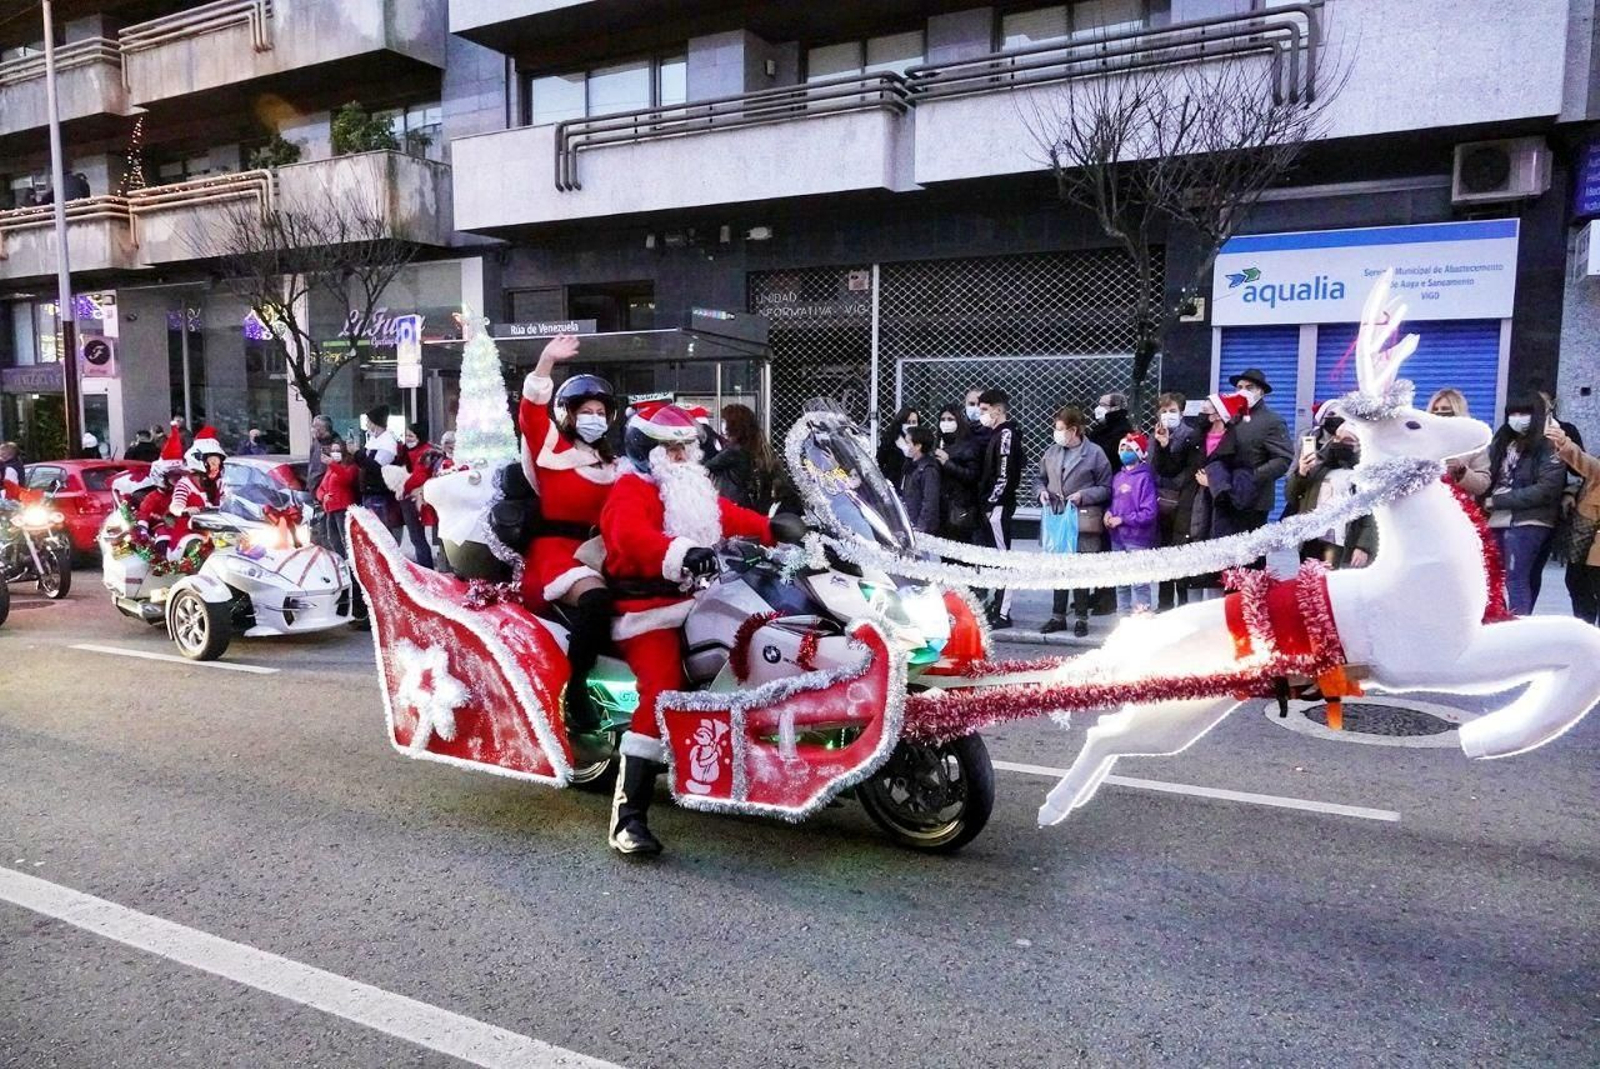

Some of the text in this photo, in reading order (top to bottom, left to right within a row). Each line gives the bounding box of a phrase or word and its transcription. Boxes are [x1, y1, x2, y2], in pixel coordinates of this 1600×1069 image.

[1433, 266, 1442, 274] de
[1243, 275, 1345, 309] aqualia
[1421, 291, 1441, 300] VIGO
[510, 321, 579, 335] Rúa de Venezuela
